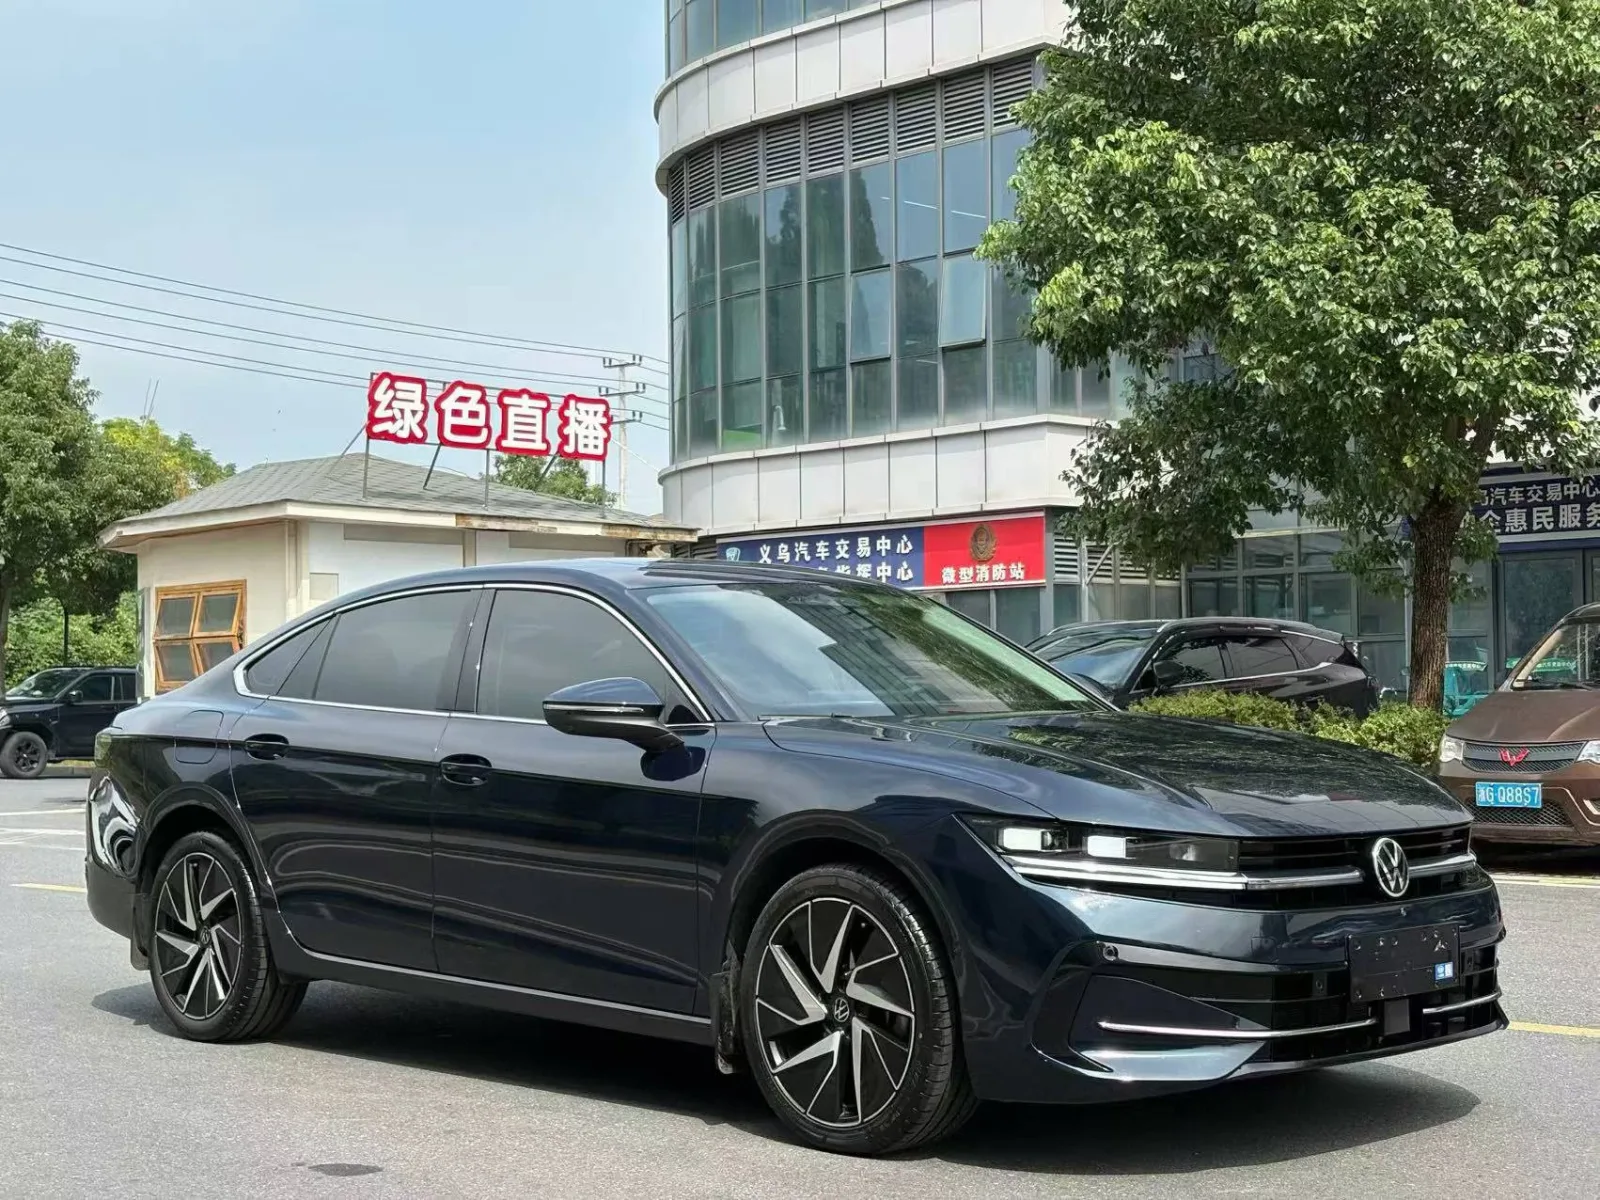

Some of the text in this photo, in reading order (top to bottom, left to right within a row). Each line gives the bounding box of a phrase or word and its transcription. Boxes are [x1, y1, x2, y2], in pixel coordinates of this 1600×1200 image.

[371, 375, 609, 458] 绿色直播
[758, 534, 913, 564] 义乌汽车交易中心
[942, 561, 1025, 584] 微型消防站
